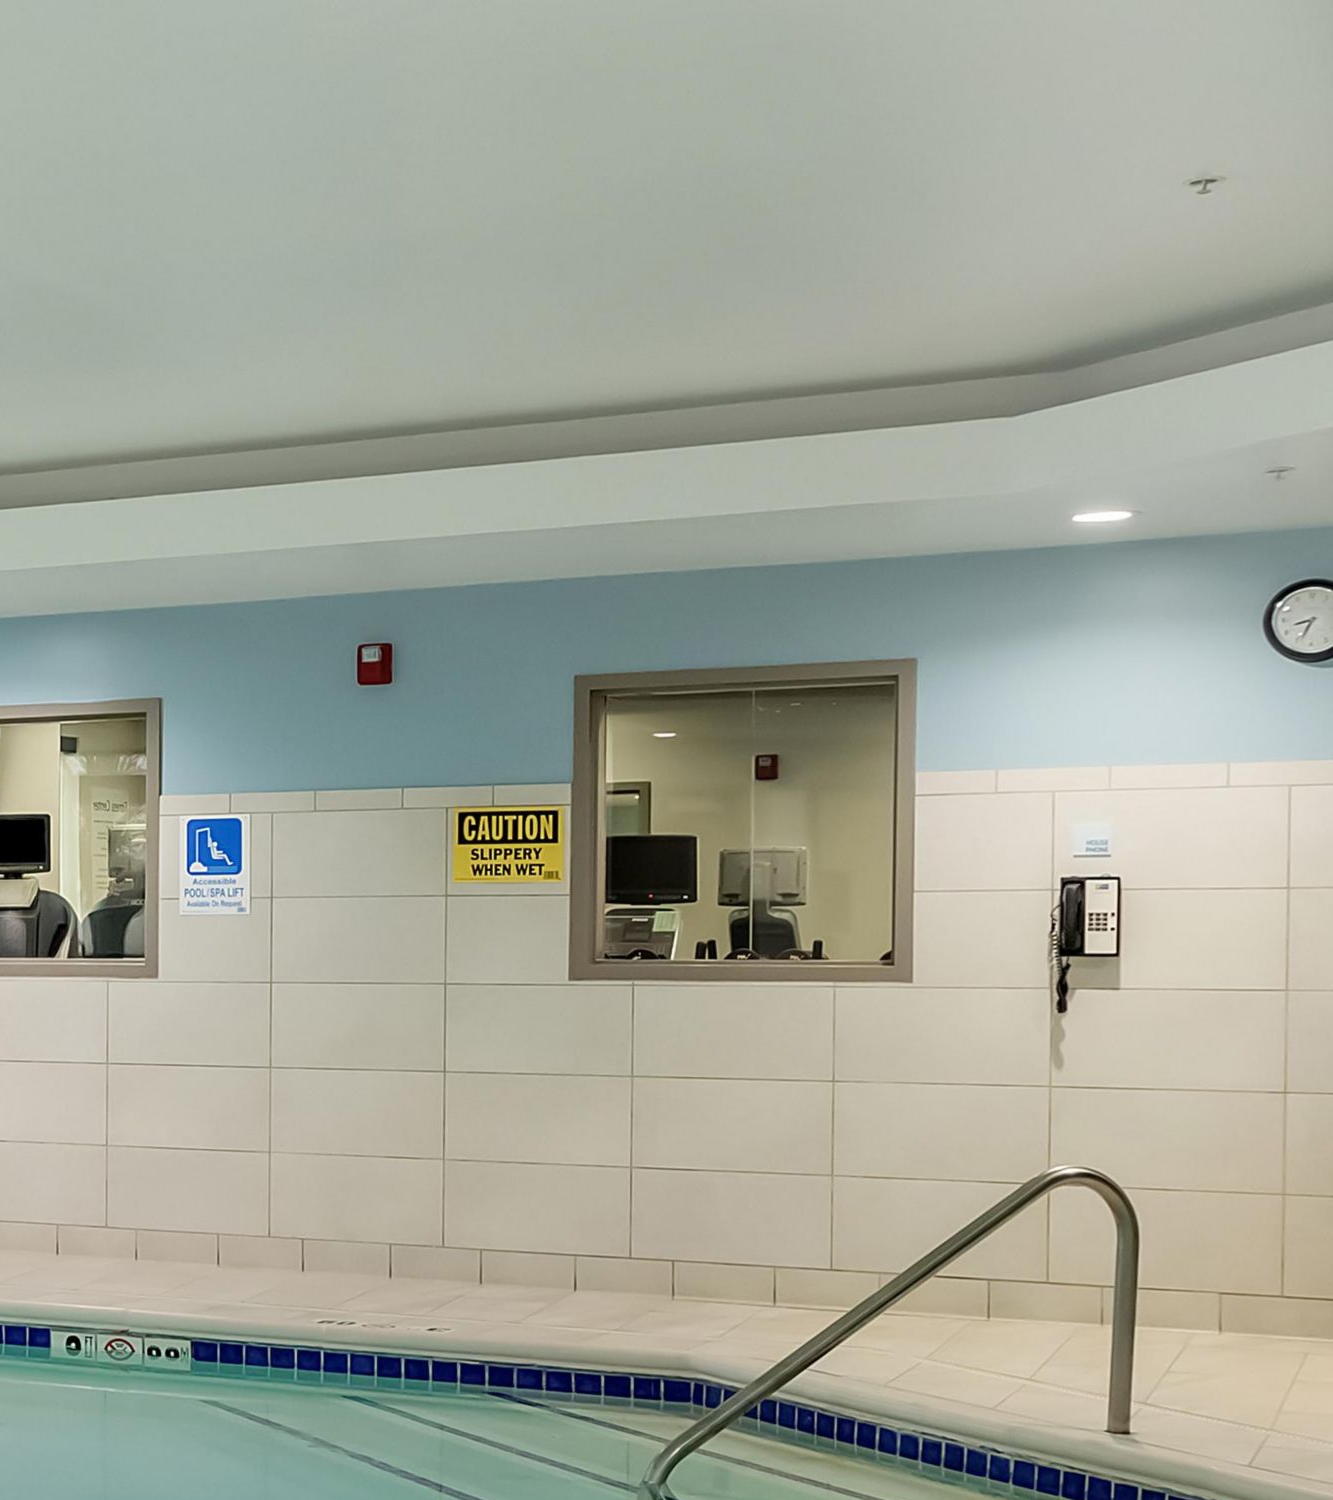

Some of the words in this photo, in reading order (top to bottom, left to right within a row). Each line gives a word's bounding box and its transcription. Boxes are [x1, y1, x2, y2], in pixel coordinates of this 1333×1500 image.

[462, 814, 554, 842] CAUTION
[470, 847, 543, 861] SLIPPERY
[471, 863, 512, 877] WHEN
[515, 863, 545, 876] WET
[192, 877, 237, 886] Accessible
[227, 887, 245, 898] LIFT
